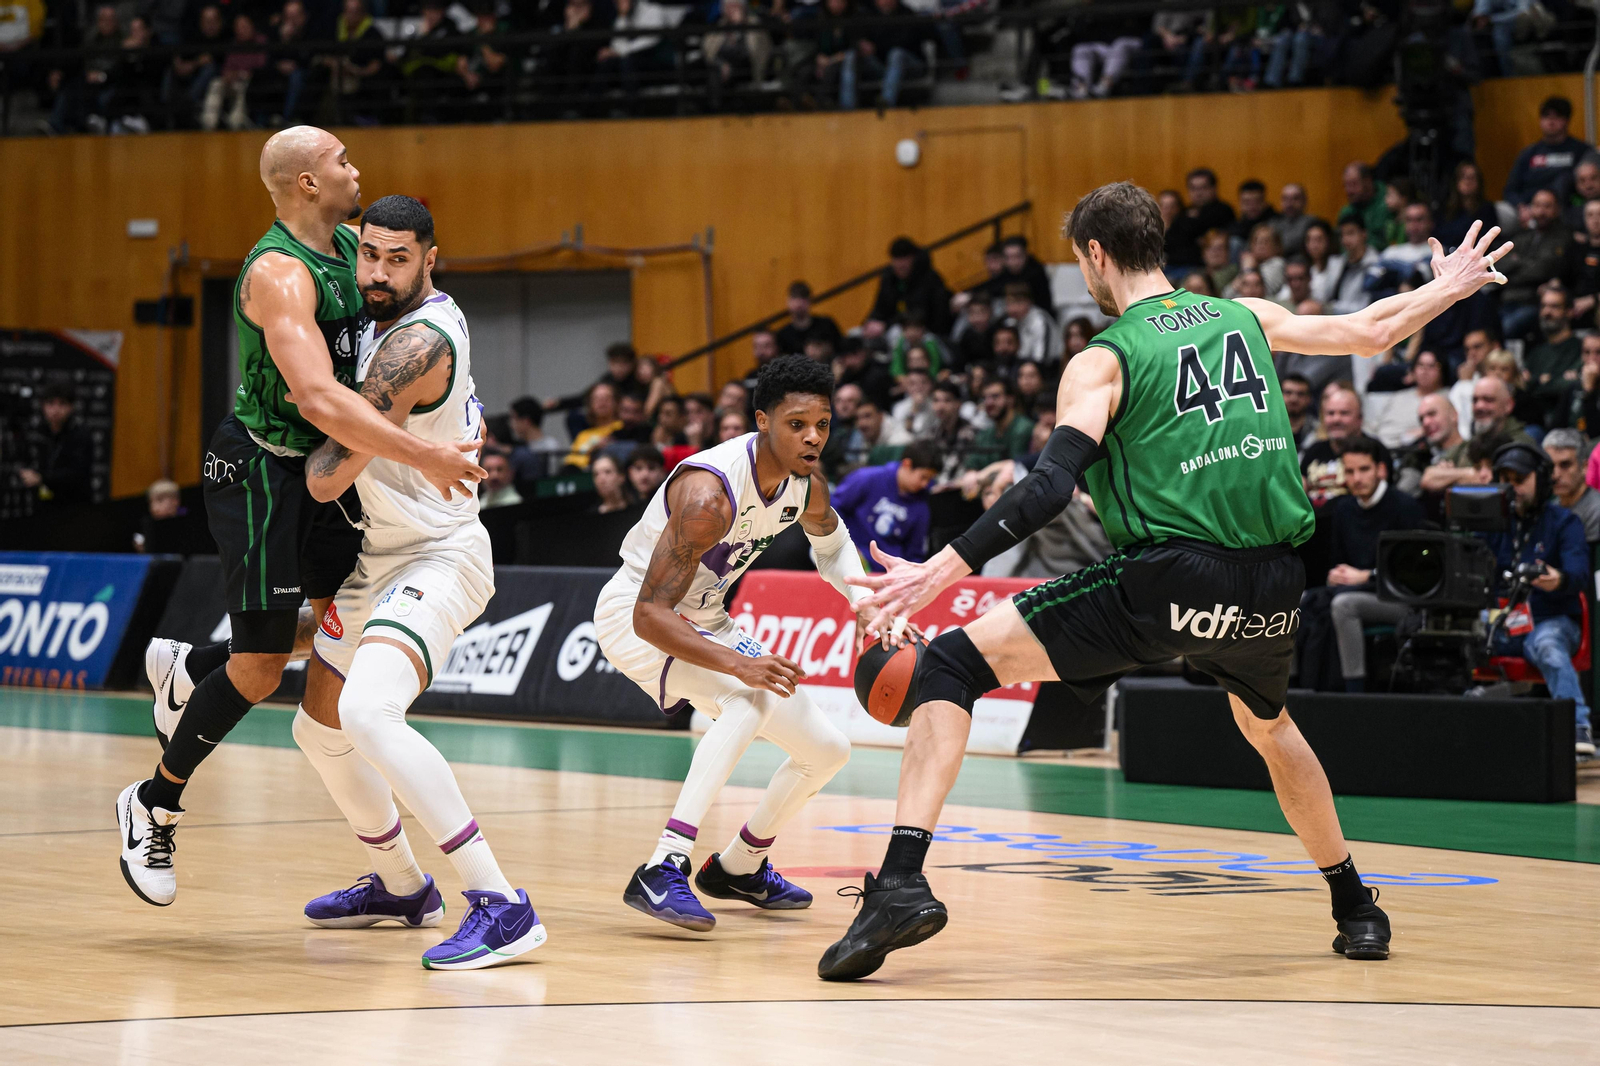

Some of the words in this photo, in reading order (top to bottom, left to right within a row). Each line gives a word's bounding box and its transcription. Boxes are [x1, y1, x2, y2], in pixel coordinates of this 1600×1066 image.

[1145, 301, 1221, 334] TOMIC
[1173, 329, 1269, 426] 44
[1180, 444, 1240, 475] BADALONA
[404, 589, 418, 598] acb
